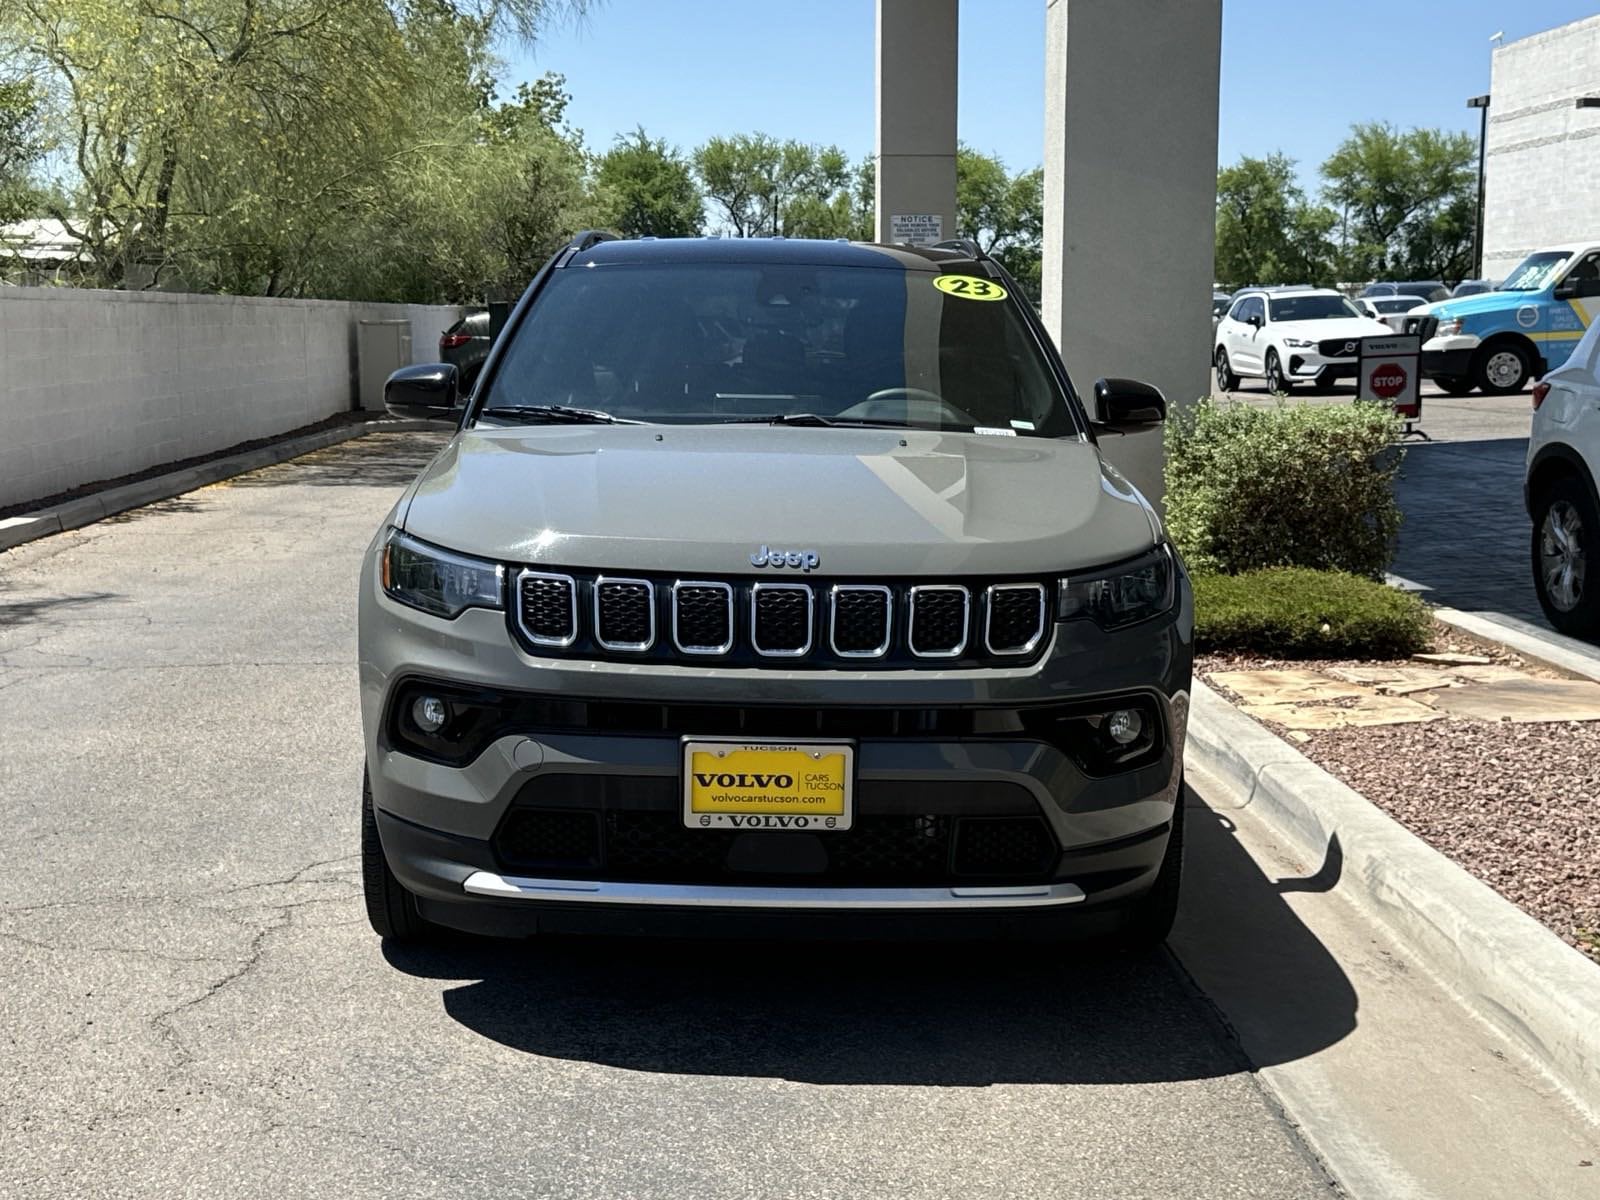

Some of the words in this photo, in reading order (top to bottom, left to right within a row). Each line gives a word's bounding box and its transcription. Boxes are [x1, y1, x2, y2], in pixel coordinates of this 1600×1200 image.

[950, 279, 991, 295] 23
[1374, 376, 1403, 388] STOP
[750, 544, 820, 572] Jeep
[694, 773, 793, 789] VOLVO
[805, 774, 830, 782] CARS
[805, 782, 845, 791] TUCSON
[711, 792, 826, 804] volvocarstucson.com
[727, 815, 809, 828] VOLVO
